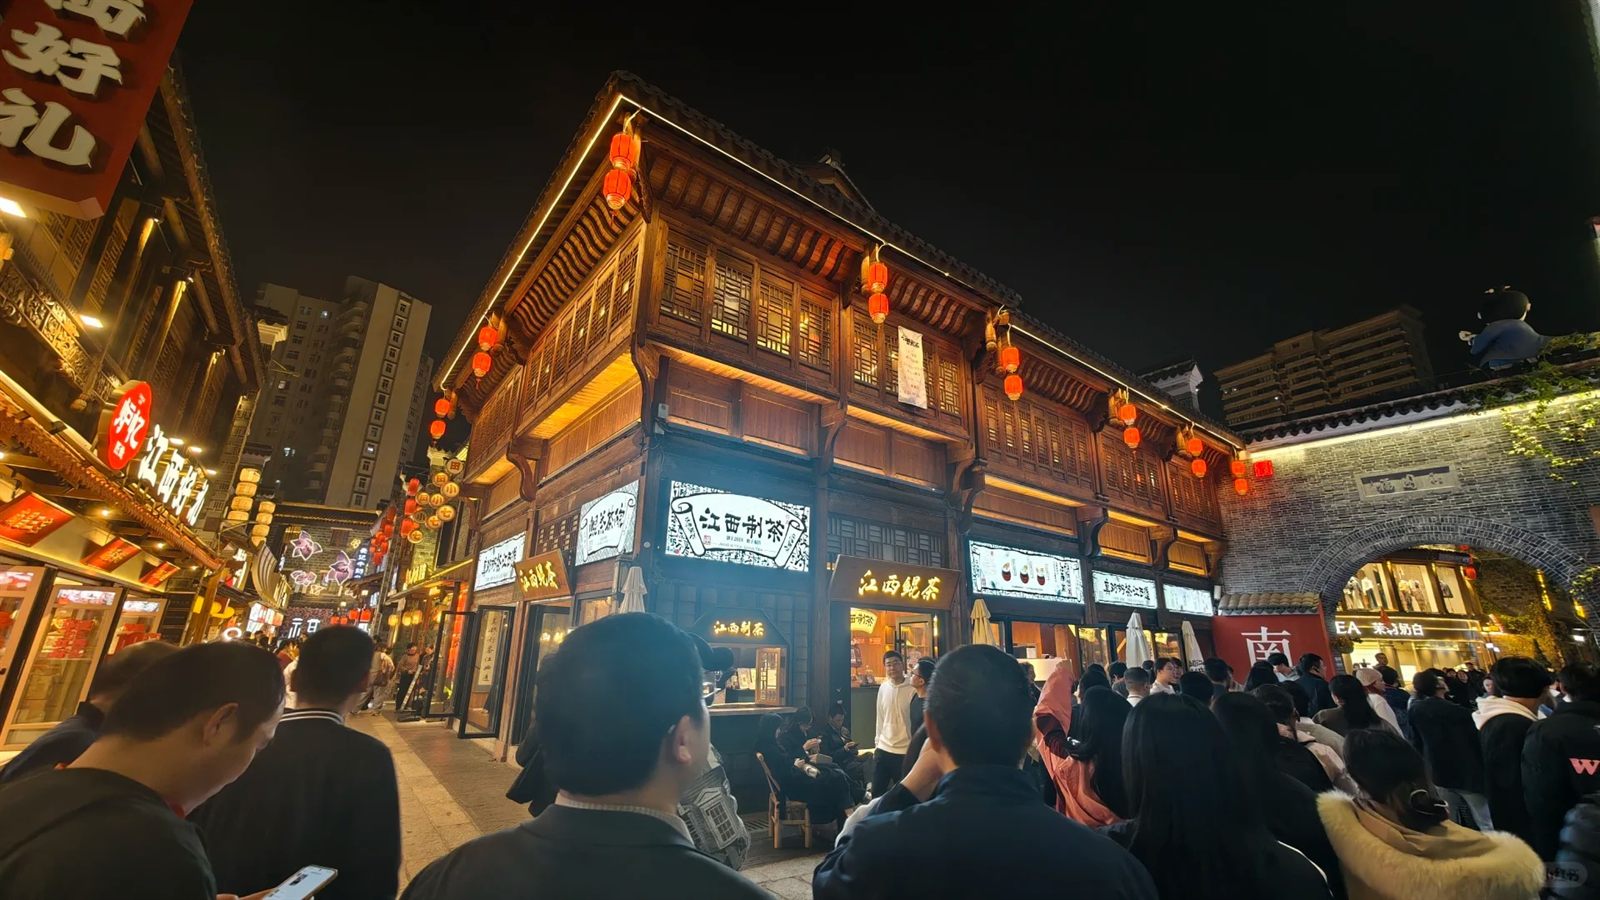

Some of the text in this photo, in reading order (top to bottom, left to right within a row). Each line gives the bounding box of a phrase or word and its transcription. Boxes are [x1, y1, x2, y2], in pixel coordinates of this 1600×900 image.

[138, 424, 209, 527] 江西好礼
[699, 507, 785, 543] 江西制茶
[713, 620, 765, 637] 江西制茶
[1241, 626, 1292, 668] 南
